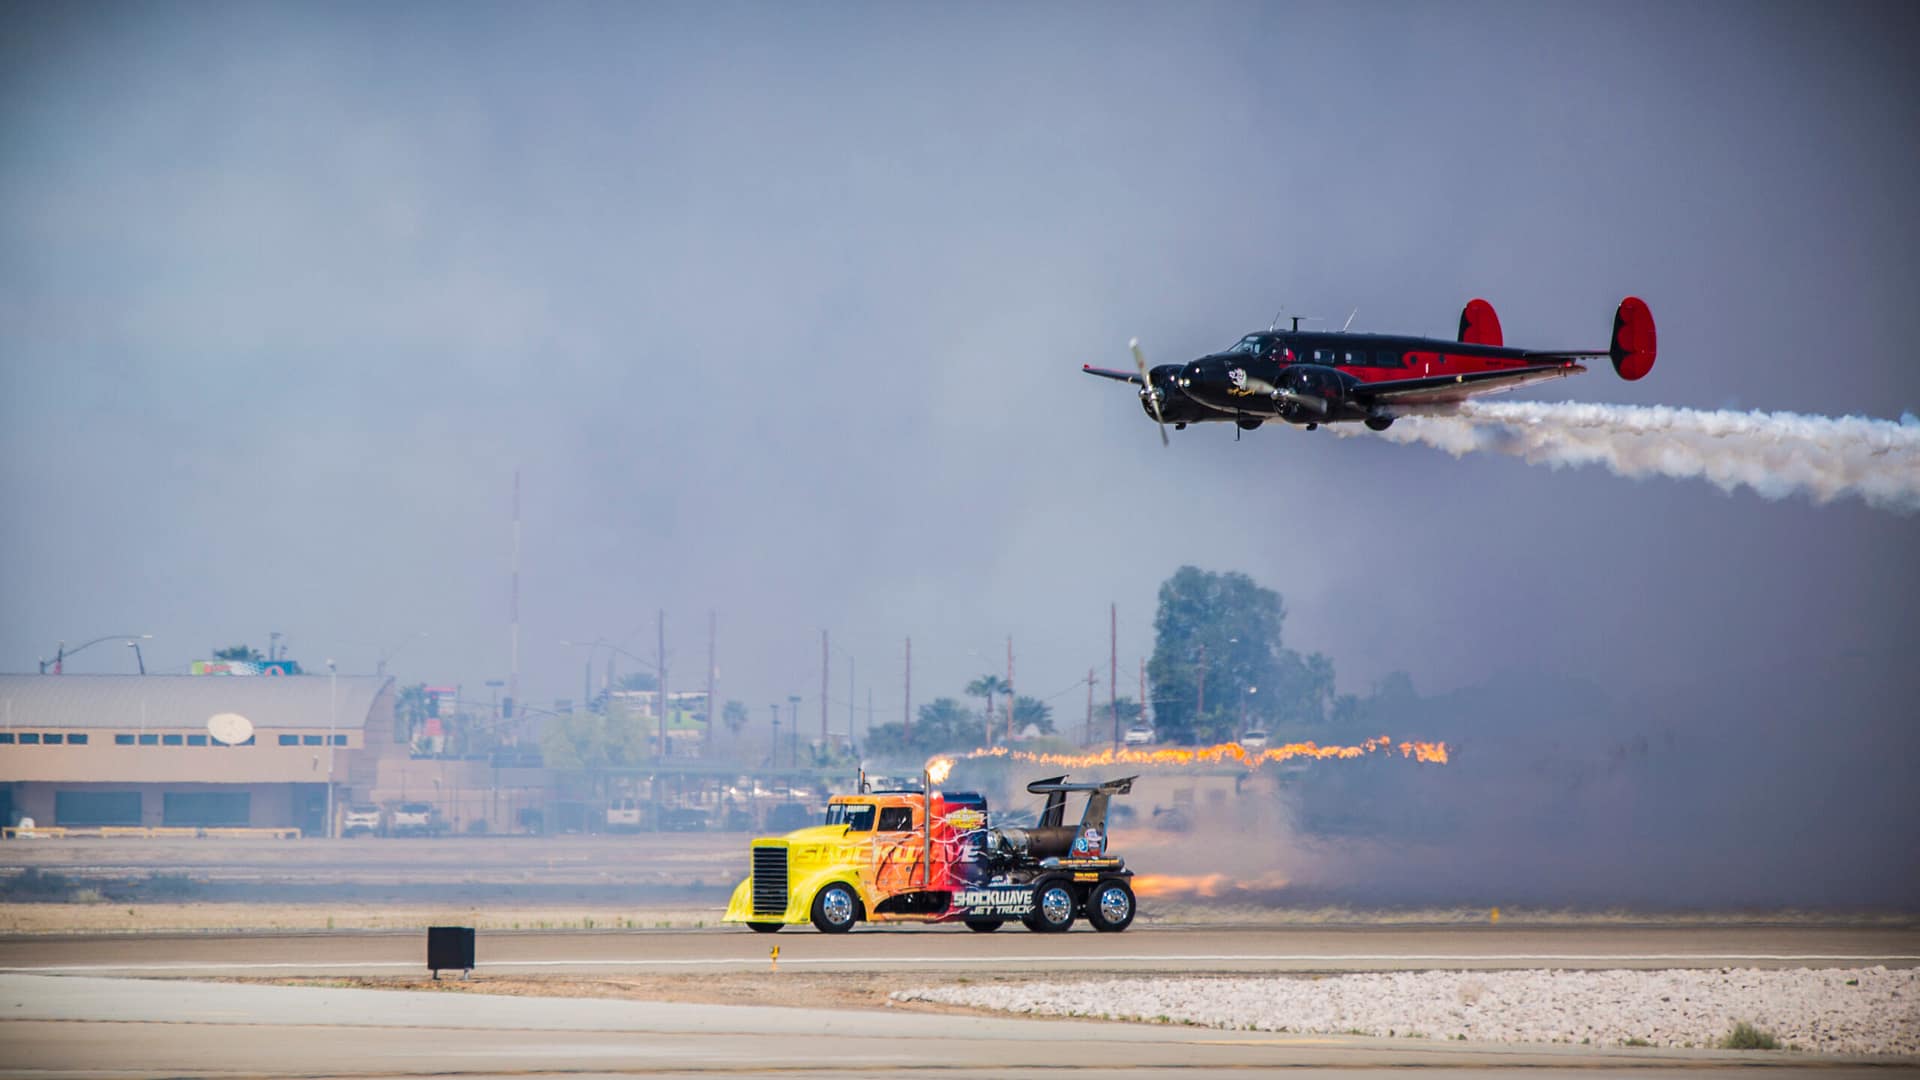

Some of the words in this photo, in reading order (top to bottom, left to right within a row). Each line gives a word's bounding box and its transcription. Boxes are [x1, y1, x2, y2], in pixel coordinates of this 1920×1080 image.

[953, 889, 1034, 907] SHOCKWAVE
[969, 905, 994, 915] JET
[996, 905, 1036, 915] TRUCK
